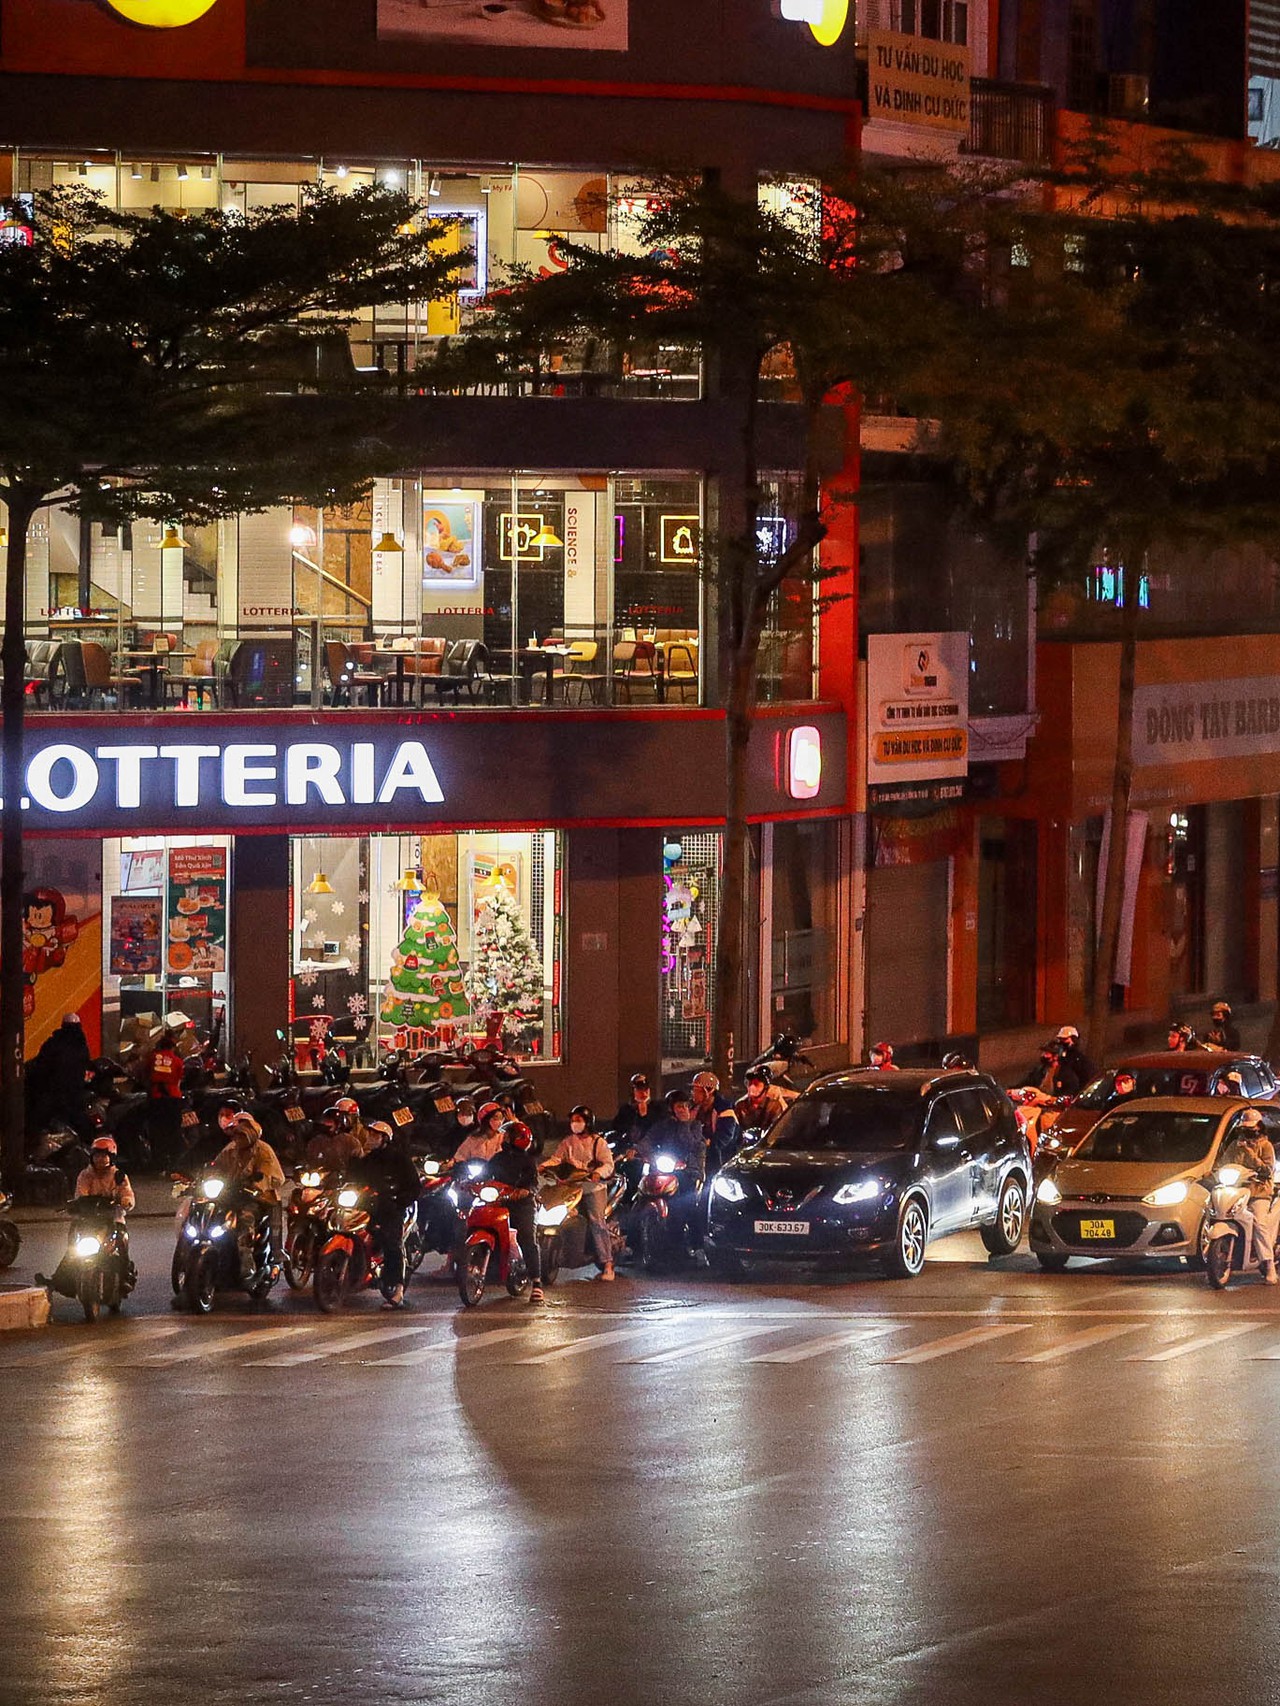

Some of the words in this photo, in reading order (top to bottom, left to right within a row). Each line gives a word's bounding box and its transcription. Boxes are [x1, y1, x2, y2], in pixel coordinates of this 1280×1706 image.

[896, 42, 920, 73] VẤN
[923, 54, 938, 77] DU
[942, 60, 964, 87] HỌC
[875, 80, 891, 109] VÀ
[894, 89, 921, 117] ĐỊNH
[567, 508, 577, 564] SCIENCE
[243, 607, 303, 616] LOTTERIA
[437, 607, 495, 616] LOTTERIA
